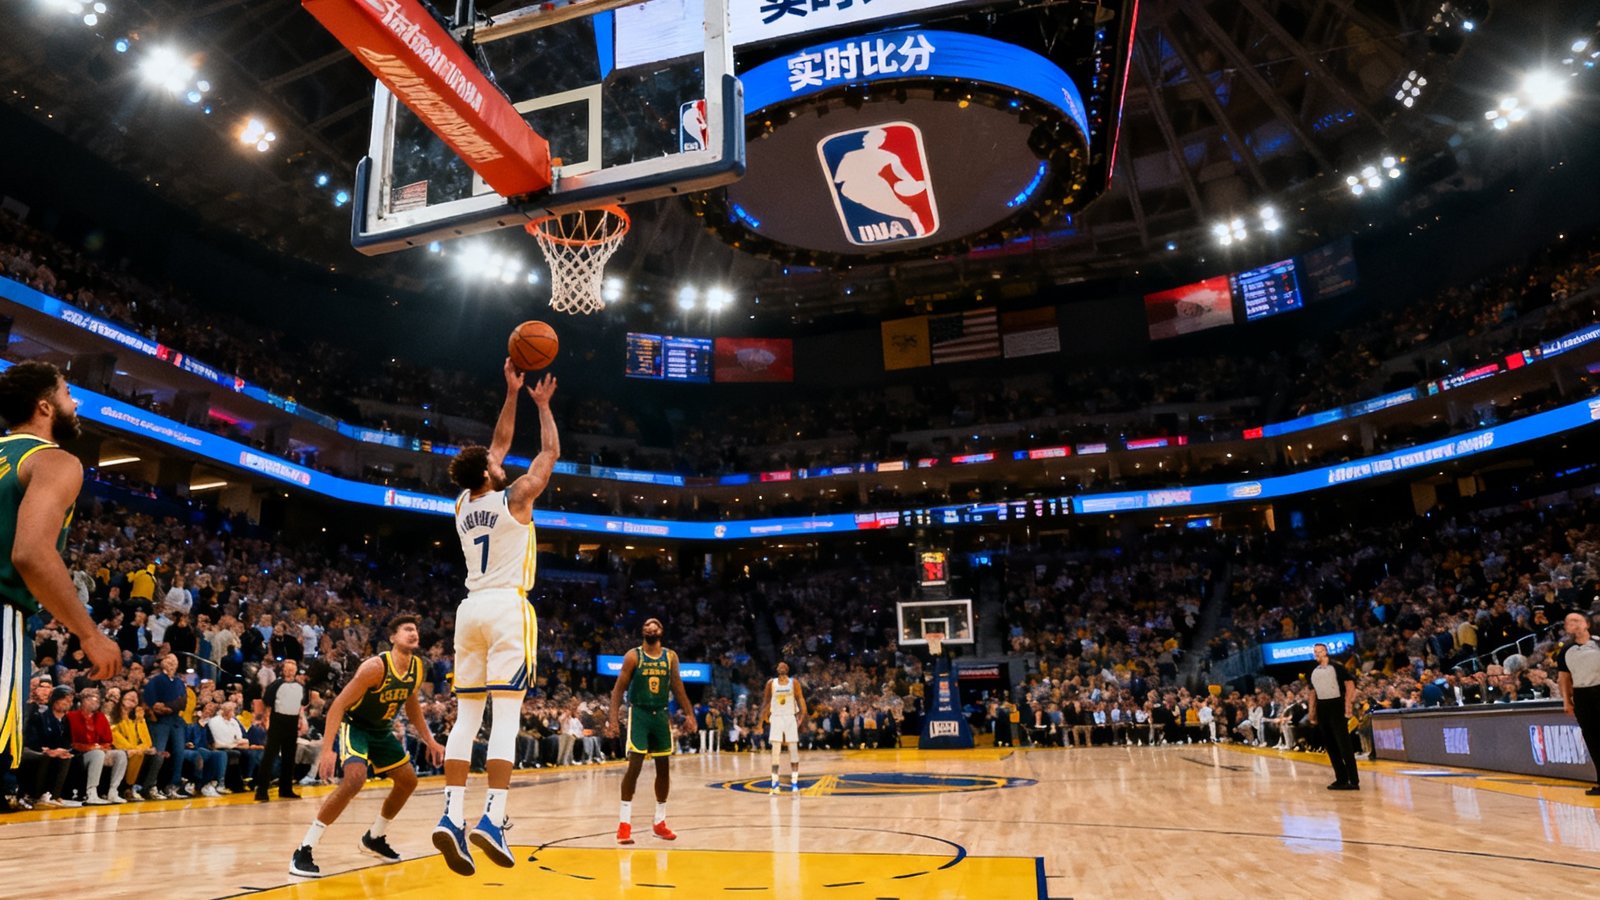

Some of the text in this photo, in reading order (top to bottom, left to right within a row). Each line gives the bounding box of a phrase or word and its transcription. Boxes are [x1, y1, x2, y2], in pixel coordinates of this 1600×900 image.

[787, 34, 936, 92] 实时比分
[473, 534, 490, 575] 7
